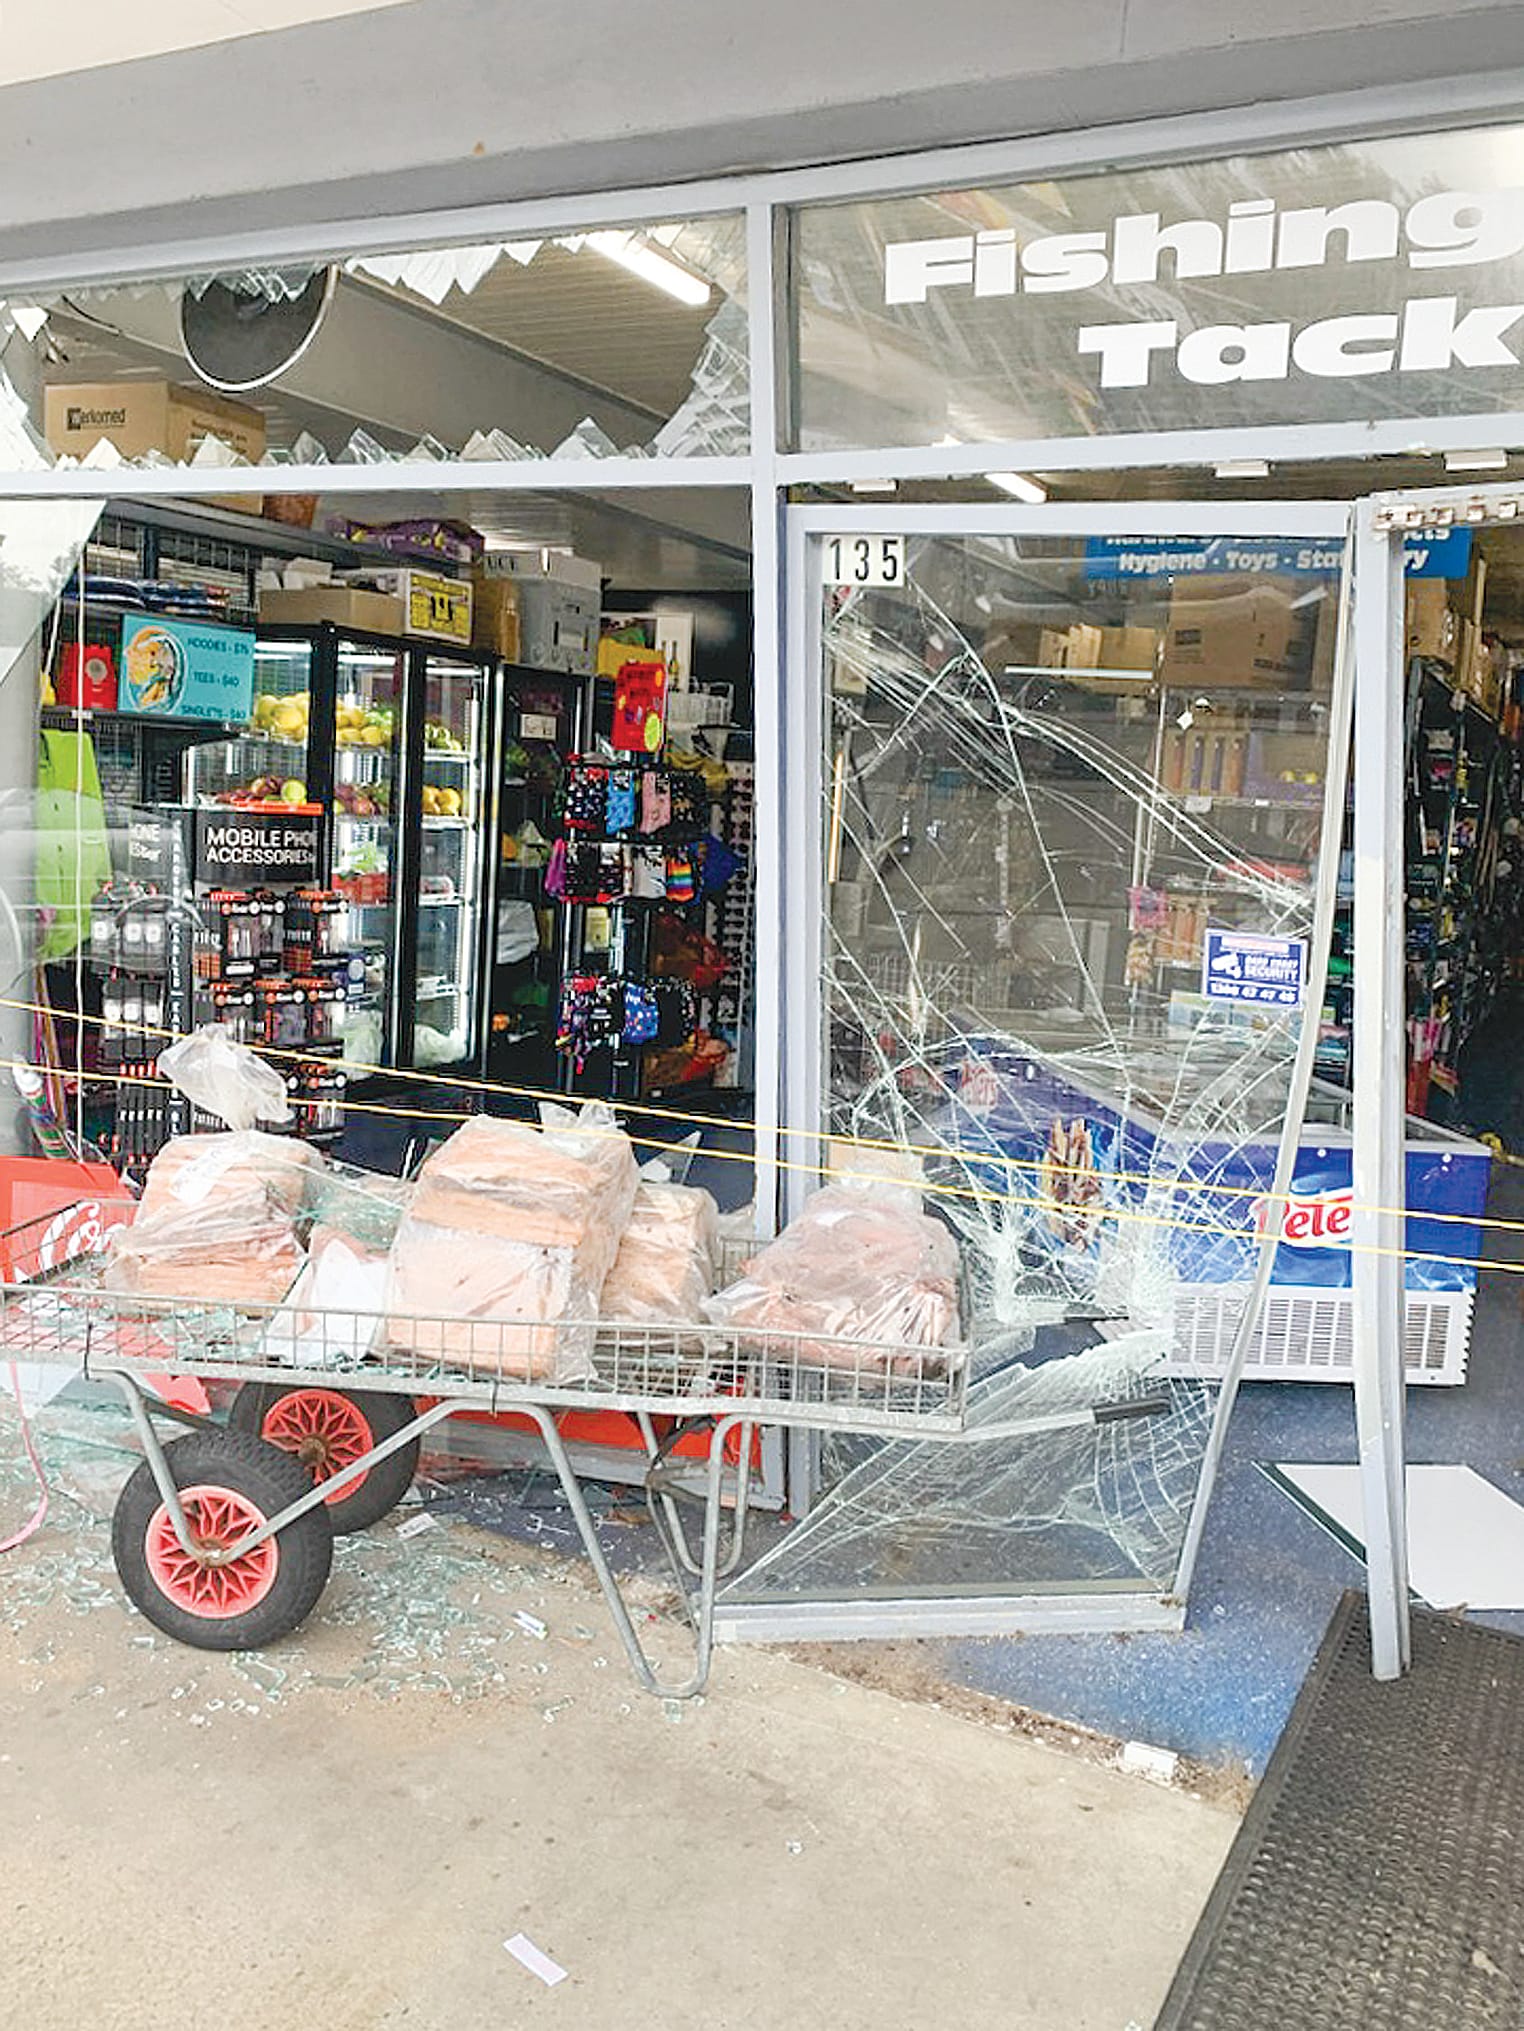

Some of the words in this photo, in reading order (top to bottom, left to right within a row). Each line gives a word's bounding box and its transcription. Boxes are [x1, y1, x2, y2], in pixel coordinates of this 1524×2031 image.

[884, 191, 1524, 305] Fishing
[1077, 297, 1522, 389] Tack
[830, 539, 900, 583] 135
[1118, 551, 1206, 574] Hygiene
[1226, 550, 1279, 573] Toys
[187, 637, 227, 653] HOODIES
[193, 671, 215, 684] TEES
[206, 826, 281, 847] MOBILE
[1243, 966, 1299, 981] SECURITY
